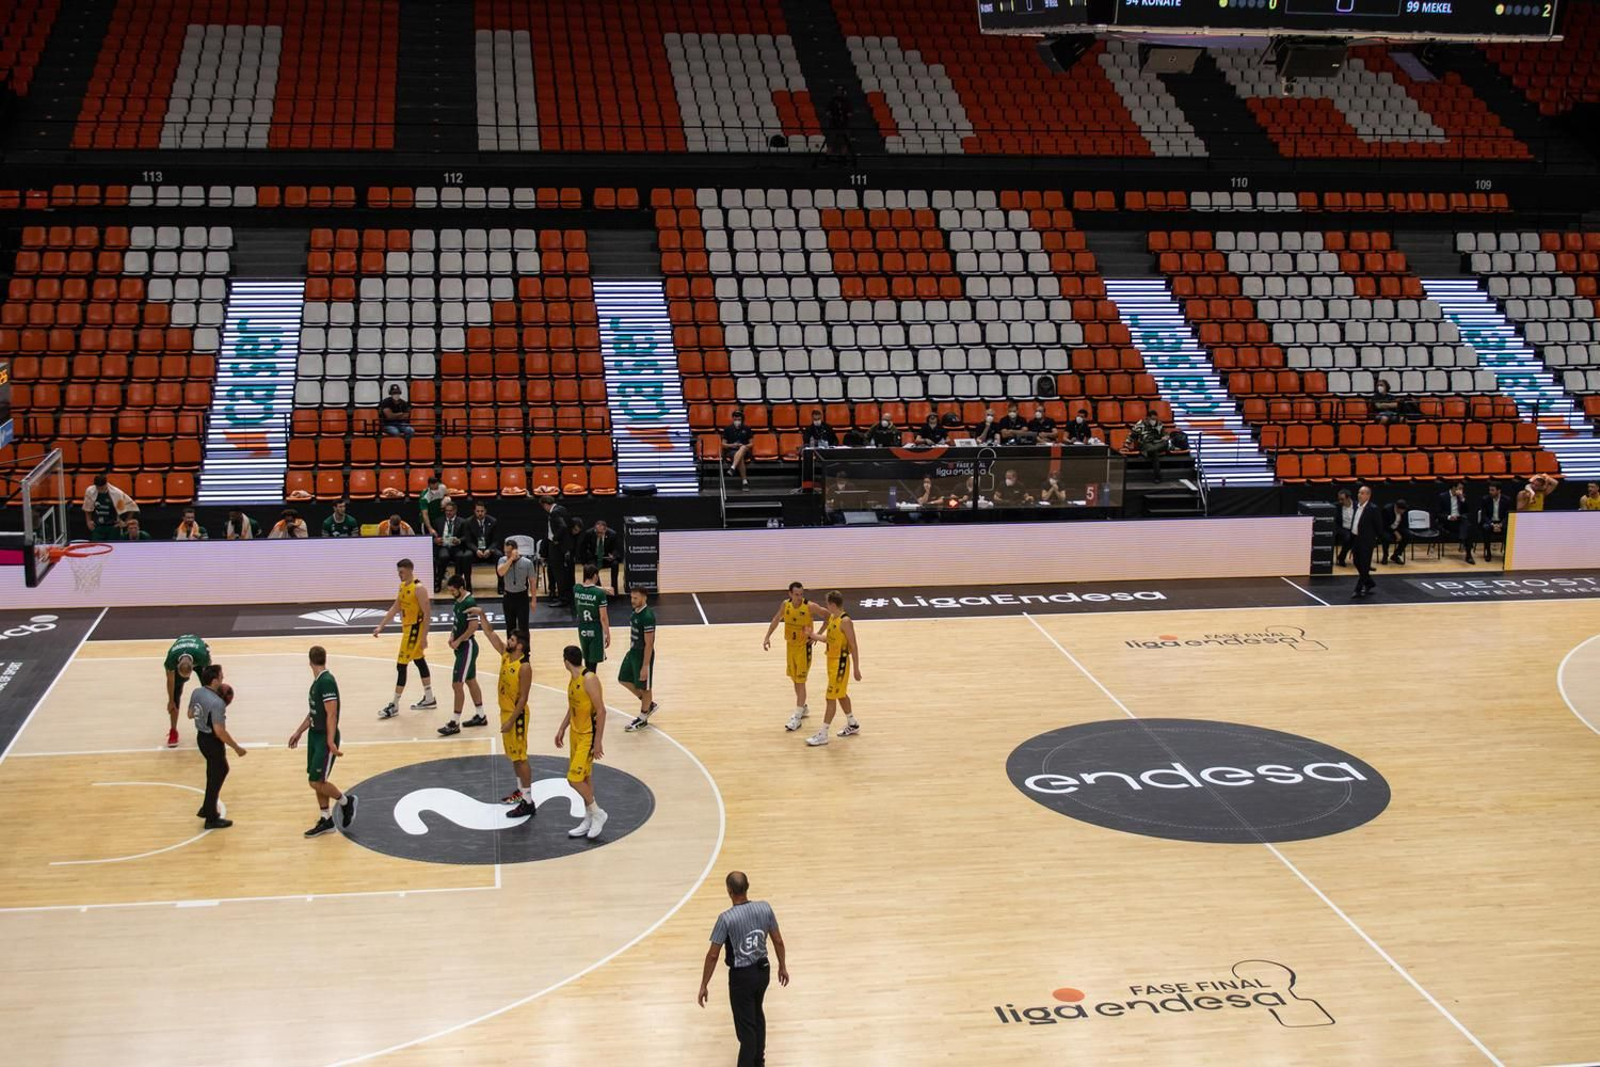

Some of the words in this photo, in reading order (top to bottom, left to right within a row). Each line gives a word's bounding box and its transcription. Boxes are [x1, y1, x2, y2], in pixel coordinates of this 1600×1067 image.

[1406, 1, 1419, 13] 99
[1421, 2, 1453, 14] MEKEL
[1542, 4, 1552, 17] 2
[142, 171, 163, 182] 113
[443, 172, 463, 184] 112
[850, 174, 867, 185] 111
[1230, 177, 1248, 188] 110
[1475, 180, 1492, 190] 109
[1086, 486, 1094, 500] 5
[859, 589, 1167, 609] #LigaEndesa
[1449, 588, 1533, 597] HOTELS
[1204, 632, 1240, 640] FASE
[1243, 631, 1290, 639] FINAL
[1124, 639, 1181, 650] liga
[1185, 636, 1300, 647] endesa
[1024, 761, 1368, 795] endesa
[746, 936, 759, 949] 54
[1129, 981, 1192, 997] FASE
[1196, 977, 1271, 993] FINAL
[993, 1003, 1089, 1027] liga
[1095, 992, 1288, 1018] endesa
